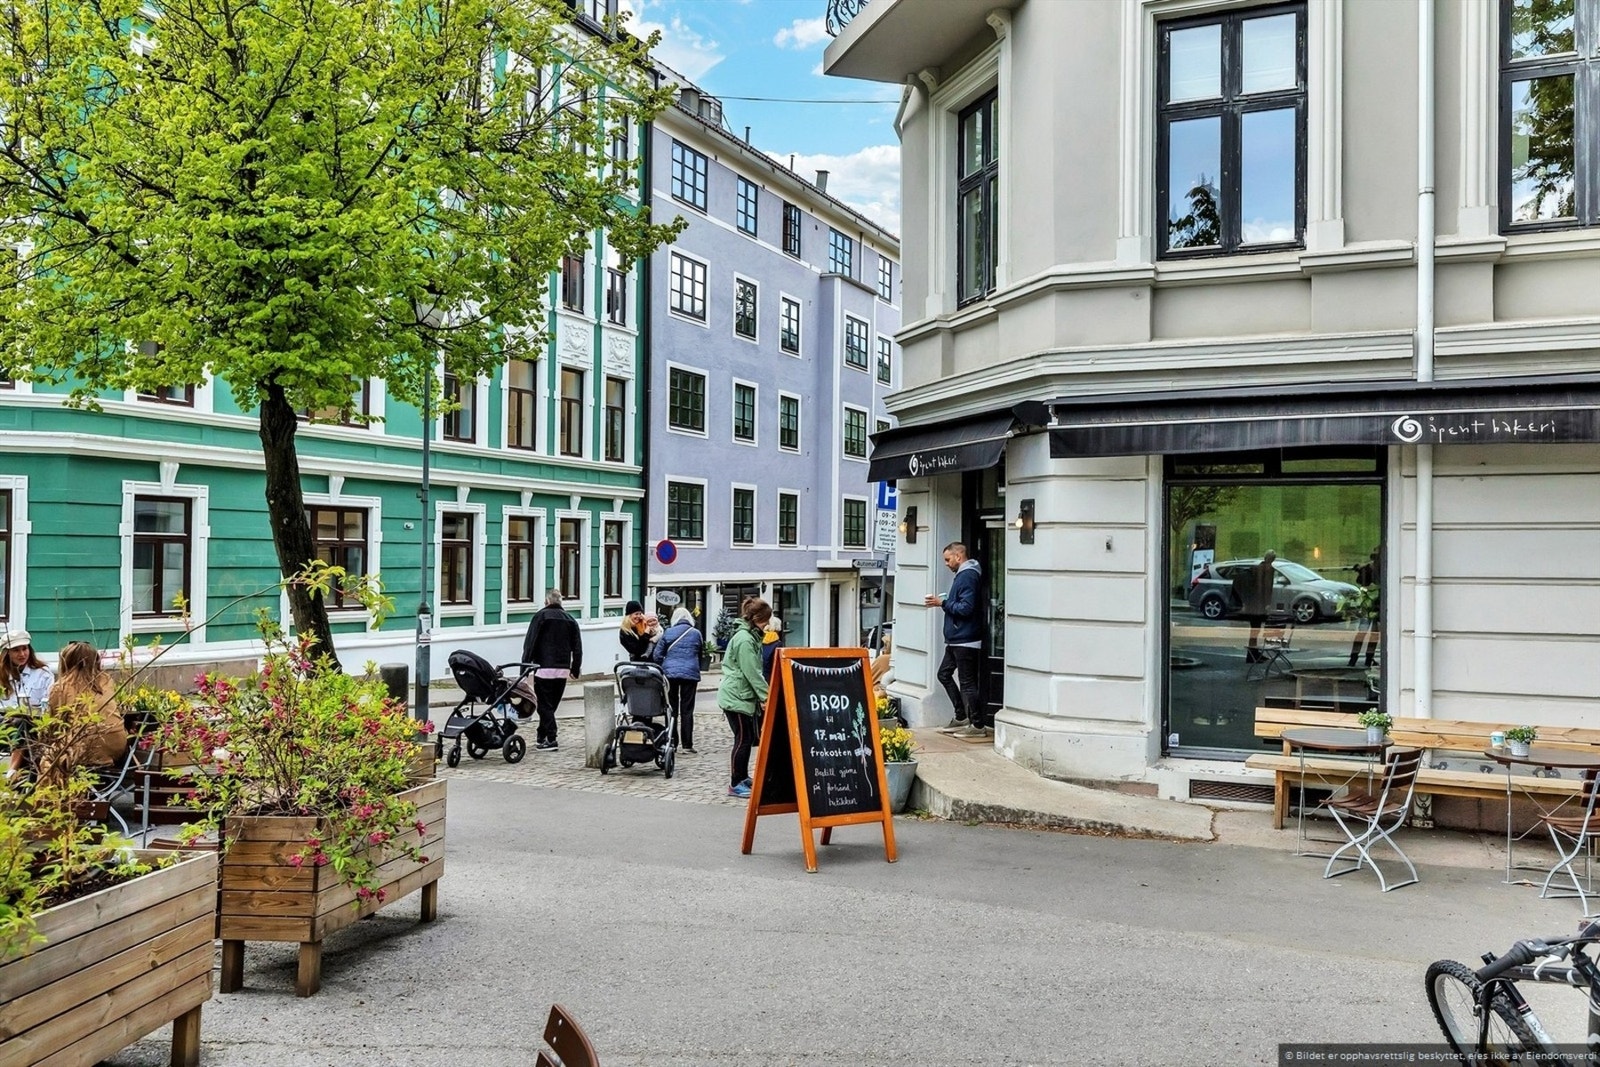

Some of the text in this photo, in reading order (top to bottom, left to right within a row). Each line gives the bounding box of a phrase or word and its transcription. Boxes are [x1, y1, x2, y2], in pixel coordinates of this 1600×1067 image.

[1492, 419, 1556, 436] bakeri
[810, 694, 850, 711] BRØD
[825, 715, 834, 723] til
[814, 729, 828, 741] 17.
[810, 746, 852, 757] frokosten
[813, 781, 821, 794] på
